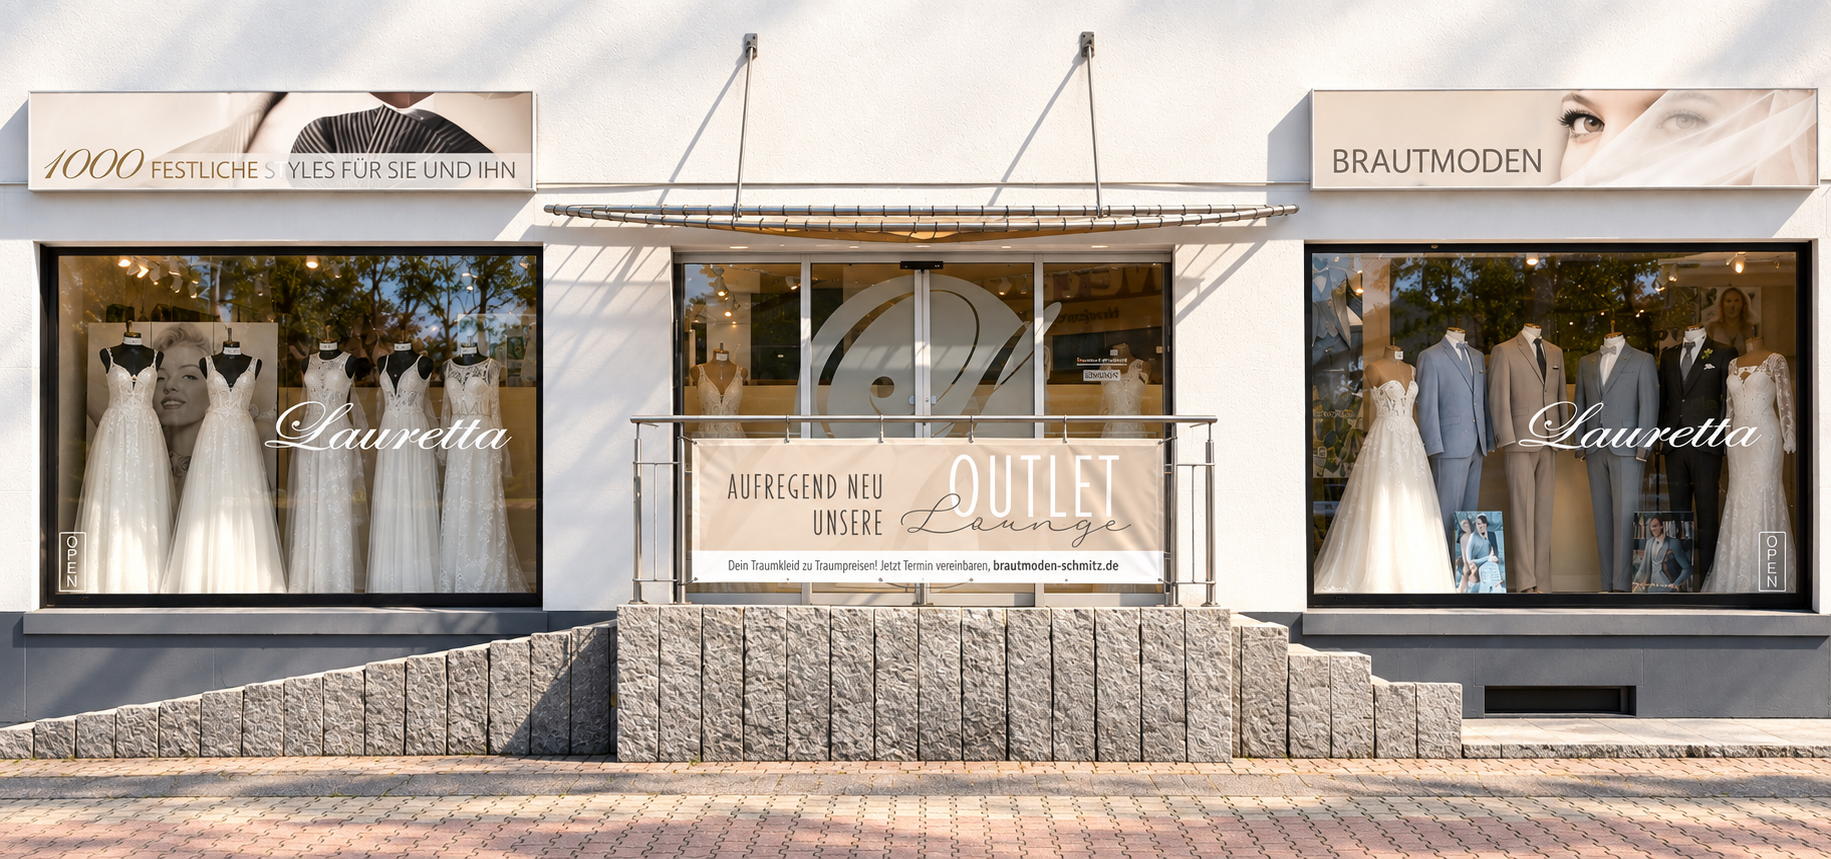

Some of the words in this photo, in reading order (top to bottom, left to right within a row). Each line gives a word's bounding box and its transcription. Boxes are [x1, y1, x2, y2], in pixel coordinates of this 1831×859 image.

[44, 148, 145, 179] 1000
[151, 161, 259, 179] FESTLICHE
[341, 157, 382, 179] FÜR
[388, 161, 417, 179] SIE
[423, 161, 472, 179] UND
[478, 161, 516, 179] IHN
[1333, 148, 1542, 174] BRAUTMODEN
[264, 401, 512, 451] Lauretta
[1518, 401, 1762, 450] Lauretta
[727, 473, 837, 500] AUFREGEND
[848, 473, 883, 500] NEU
[949, 453, 1120, 518] OUTLET
[813, 509, 883, 536] UNSERE
[900, 492, 1132, 548] Lounge
[66, 535, 78, 588] OPEN
[728, 559, 748, 571] Dein
[751, 559, 800, 571] Traumkleid
[802, 562, 813, 571] zu
[815, 559, 878, 573] Traumpreisen!
[880, 559, 901, 571] Jetzt
[903, 559, 934, 571] Termin
[936, 560, 991, 573] vereinbaren,
[993, 559, 1119, 571] brautmoden-schmitz.de
[1766, 535, 1778, 588] OPEN
